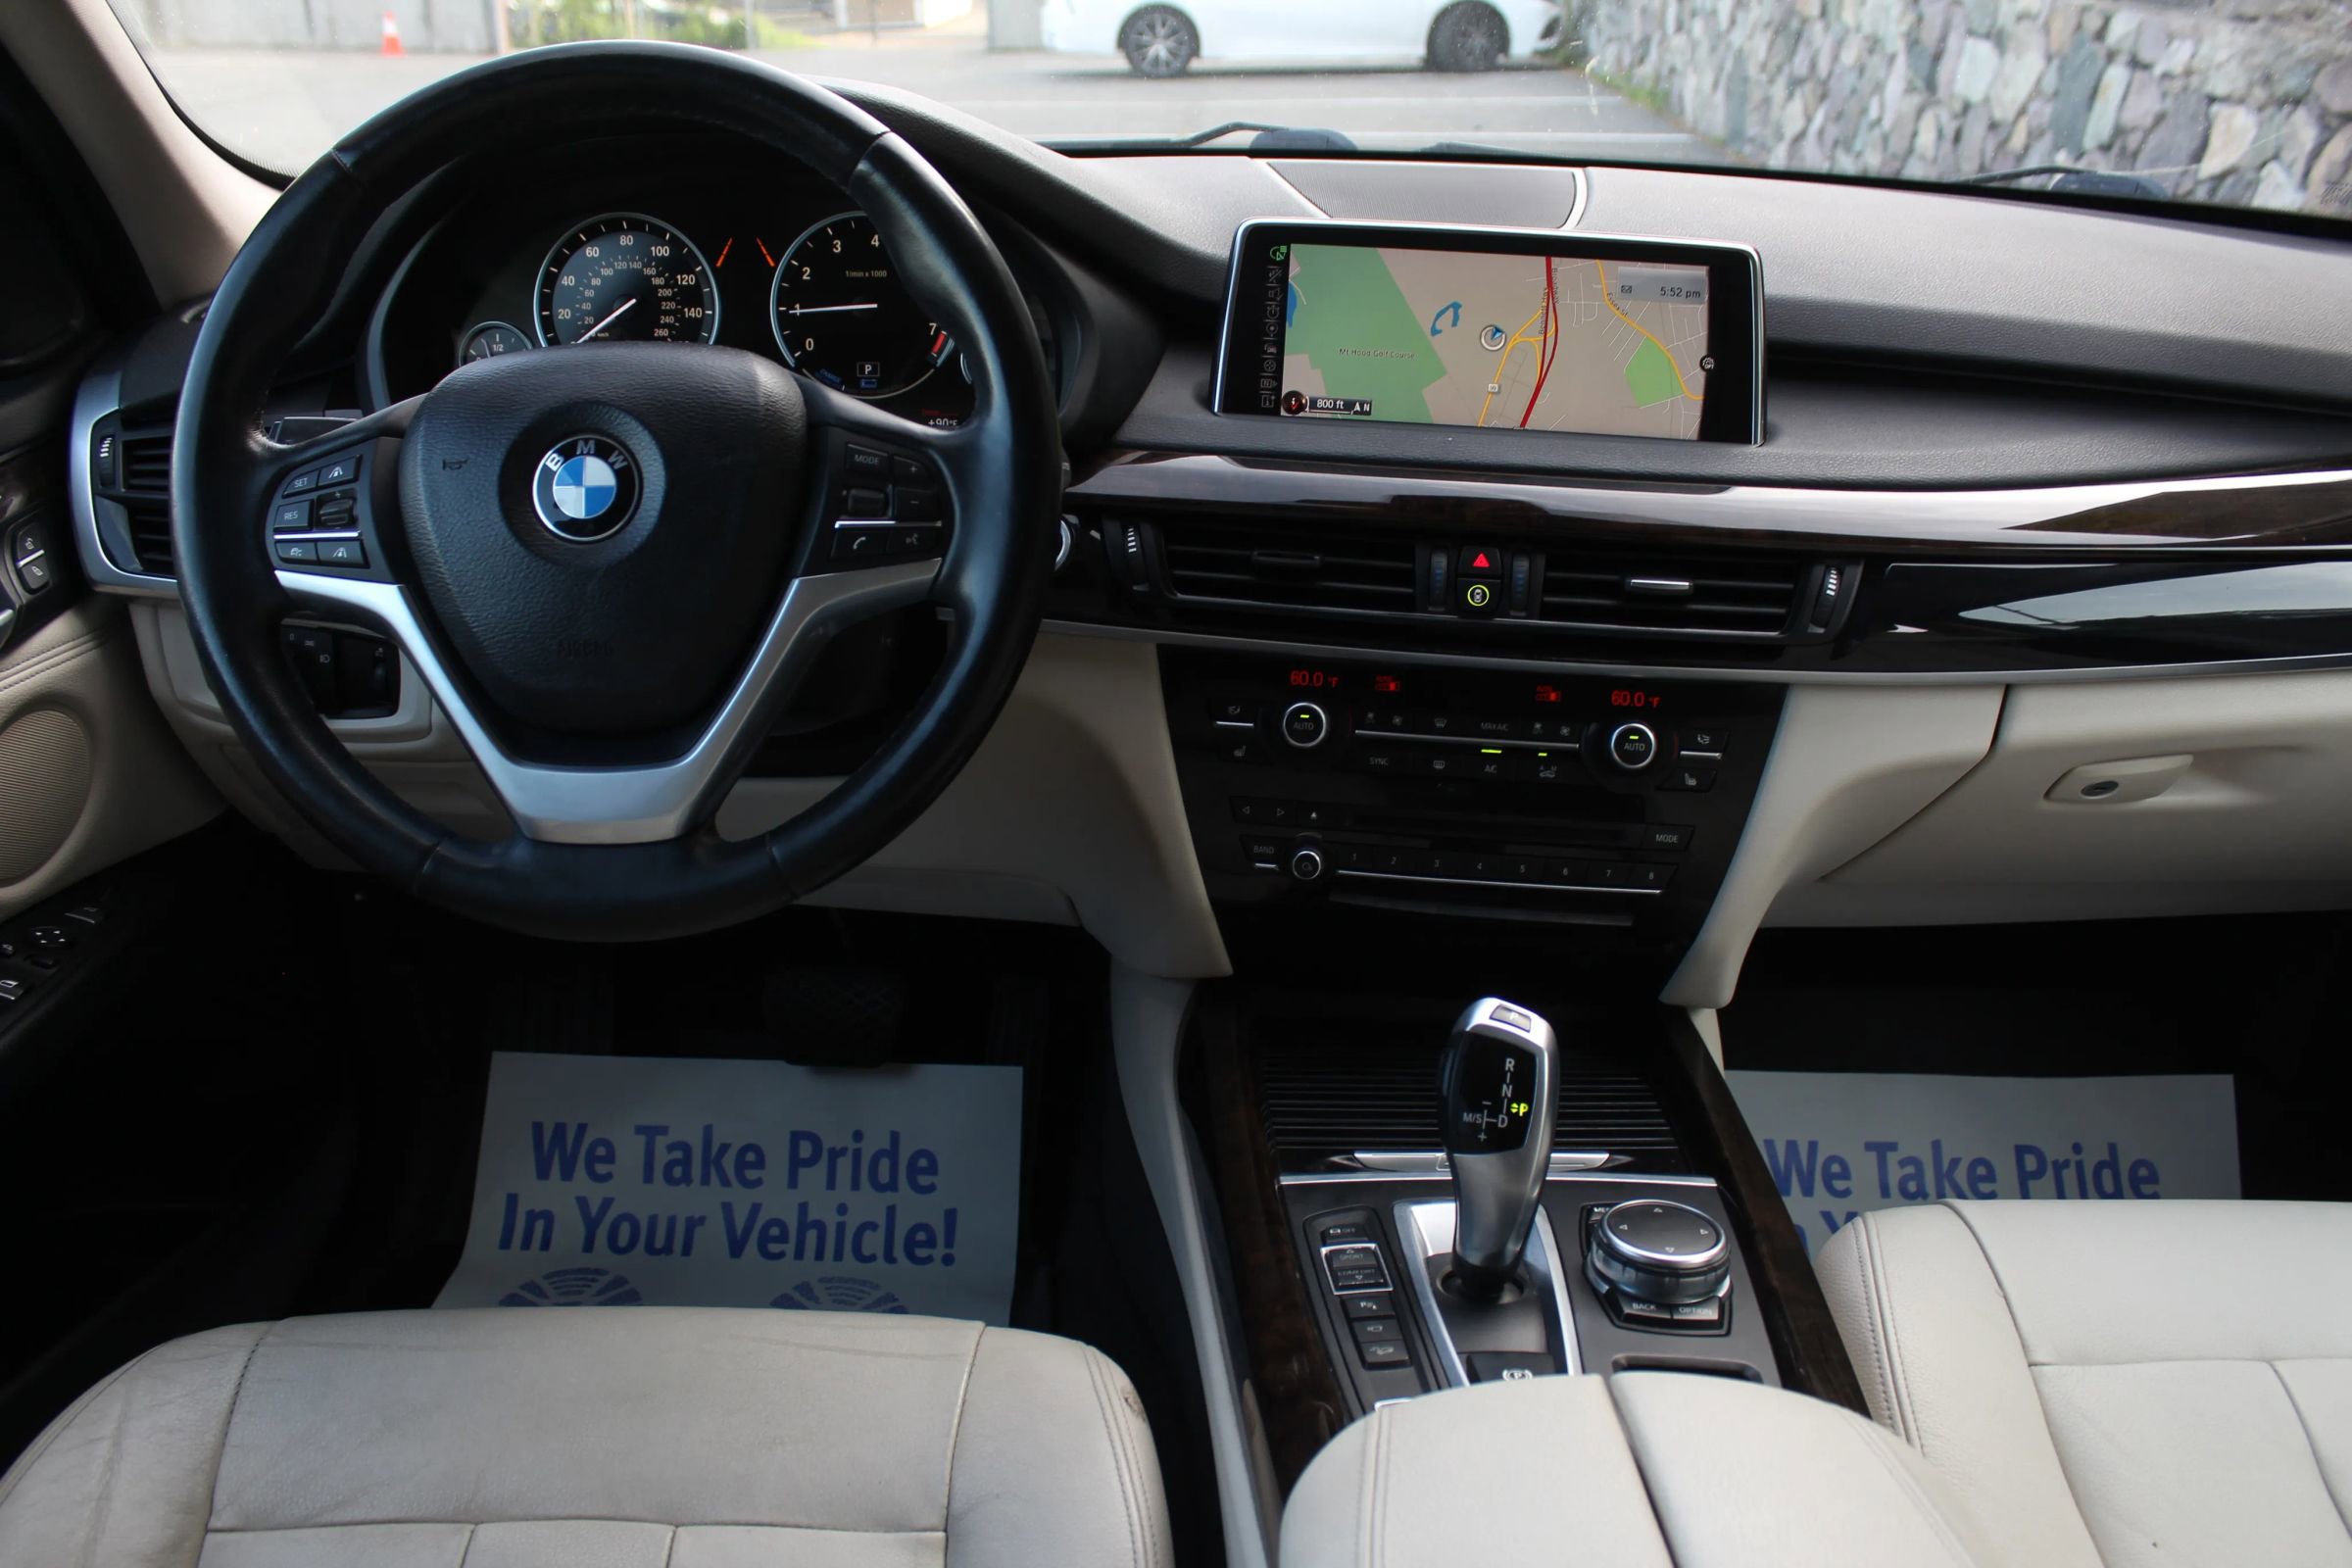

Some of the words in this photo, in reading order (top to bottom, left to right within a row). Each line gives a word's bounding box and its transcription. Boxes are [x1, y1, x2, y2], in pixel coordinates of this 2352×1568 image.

[619, 234, 634, 246] 80
[870, 234, 880, 248] 4
[650, 246, 670, 257] 100
[832, 239, 842, 253] 3
[585, 246, 600, 258] 60
[613, 261, 628, 270] 120
[628, 261, 643, 270] 140
[600, 268, 613, 276] 100
[642, 268, 657, 276] 160
[802, 267, 811, 280] 2
[561, 274, 575, 287] 40
[590, 277, 602, 286] 80
[651, 276, 665, 286] 180
[676, 273, 696, 286] 120
[584, 289, 595, 298] 60
[658, 288, 673, 297] 200
[1659, 285, 1683, 298] 5:52
[1686, 290, 1701, 300] pm
[580, 302, 592, 311] 40
[661, 301, 676, 310] 220
[557, 308, 571, 319] 20
[684, 307, 703, 318] 140
[584, 316, 595, 324] 20
[660, 316, 675, 324] 240
[654, 328, 669, 337] 260
[928, 322, 937, 336] 7
[492, 343, 505, 353] 1/2
[805, 337, 814, 352] 0
[864, 364, 873, 375] P
[1316, 398, 1335, 410] 800
[1336, 399, 1345, 410] ft
[545, 439, 628, 471] BMW
[854, 454, 880, 466] MODE
[294, 477, 309, 488] SET
[283, 511, 299, 520] RES
[1289, 669, 1324, 687] 60.0
[1610, 689, 1646, 707] 60.0
[1293, 721, 1314, 731] AUTO
[1623, 742, 1645, 752] AUTO
[1368, 757, 1389, 767] SYNC
[1655, 833, 1679, 844] MODE
[1253, 845, 1275, 855] BAND
[1351, 853, 1357, 862] 1
[1390, 856, 1397, 865] 2
[1434, 858, 1441, 868] 3
[1476, 861, 1483, 871] 4
[1520, 863, 1526, 873] 5
[1562, 866, 1569, 876] 6
[1606, 868, 1612, 878] 7
[1647, 870, 1655, 881] 8
[1505, 1057, 1515, 1072] R
[1501, 1084, 1513, 1099] N
[1519, 1102, 1529, 1117] P
[1462, 1112, 1483, 1124] M/S
[1497, 1114, 1508, 1128] D
[530, 1120, 616, 1184] We
[634, 1122, 766, 1190] Take
[787, 1128, 940, 1195] Pride
[1763, 1139, 1852, 1199] We
[1864, 1139, 1998, 1200] Take
[2013, 1142, 2161, 1200] Pride
[498, 1192, 556, 1252] In
[574, 1195, 707, 1258] Your
[720, 1200, 958, 1268] Vehicle!
[1632, 1302, 1656, 1311] BACK
[1679, 1306, 1713, 1316] OPTION
